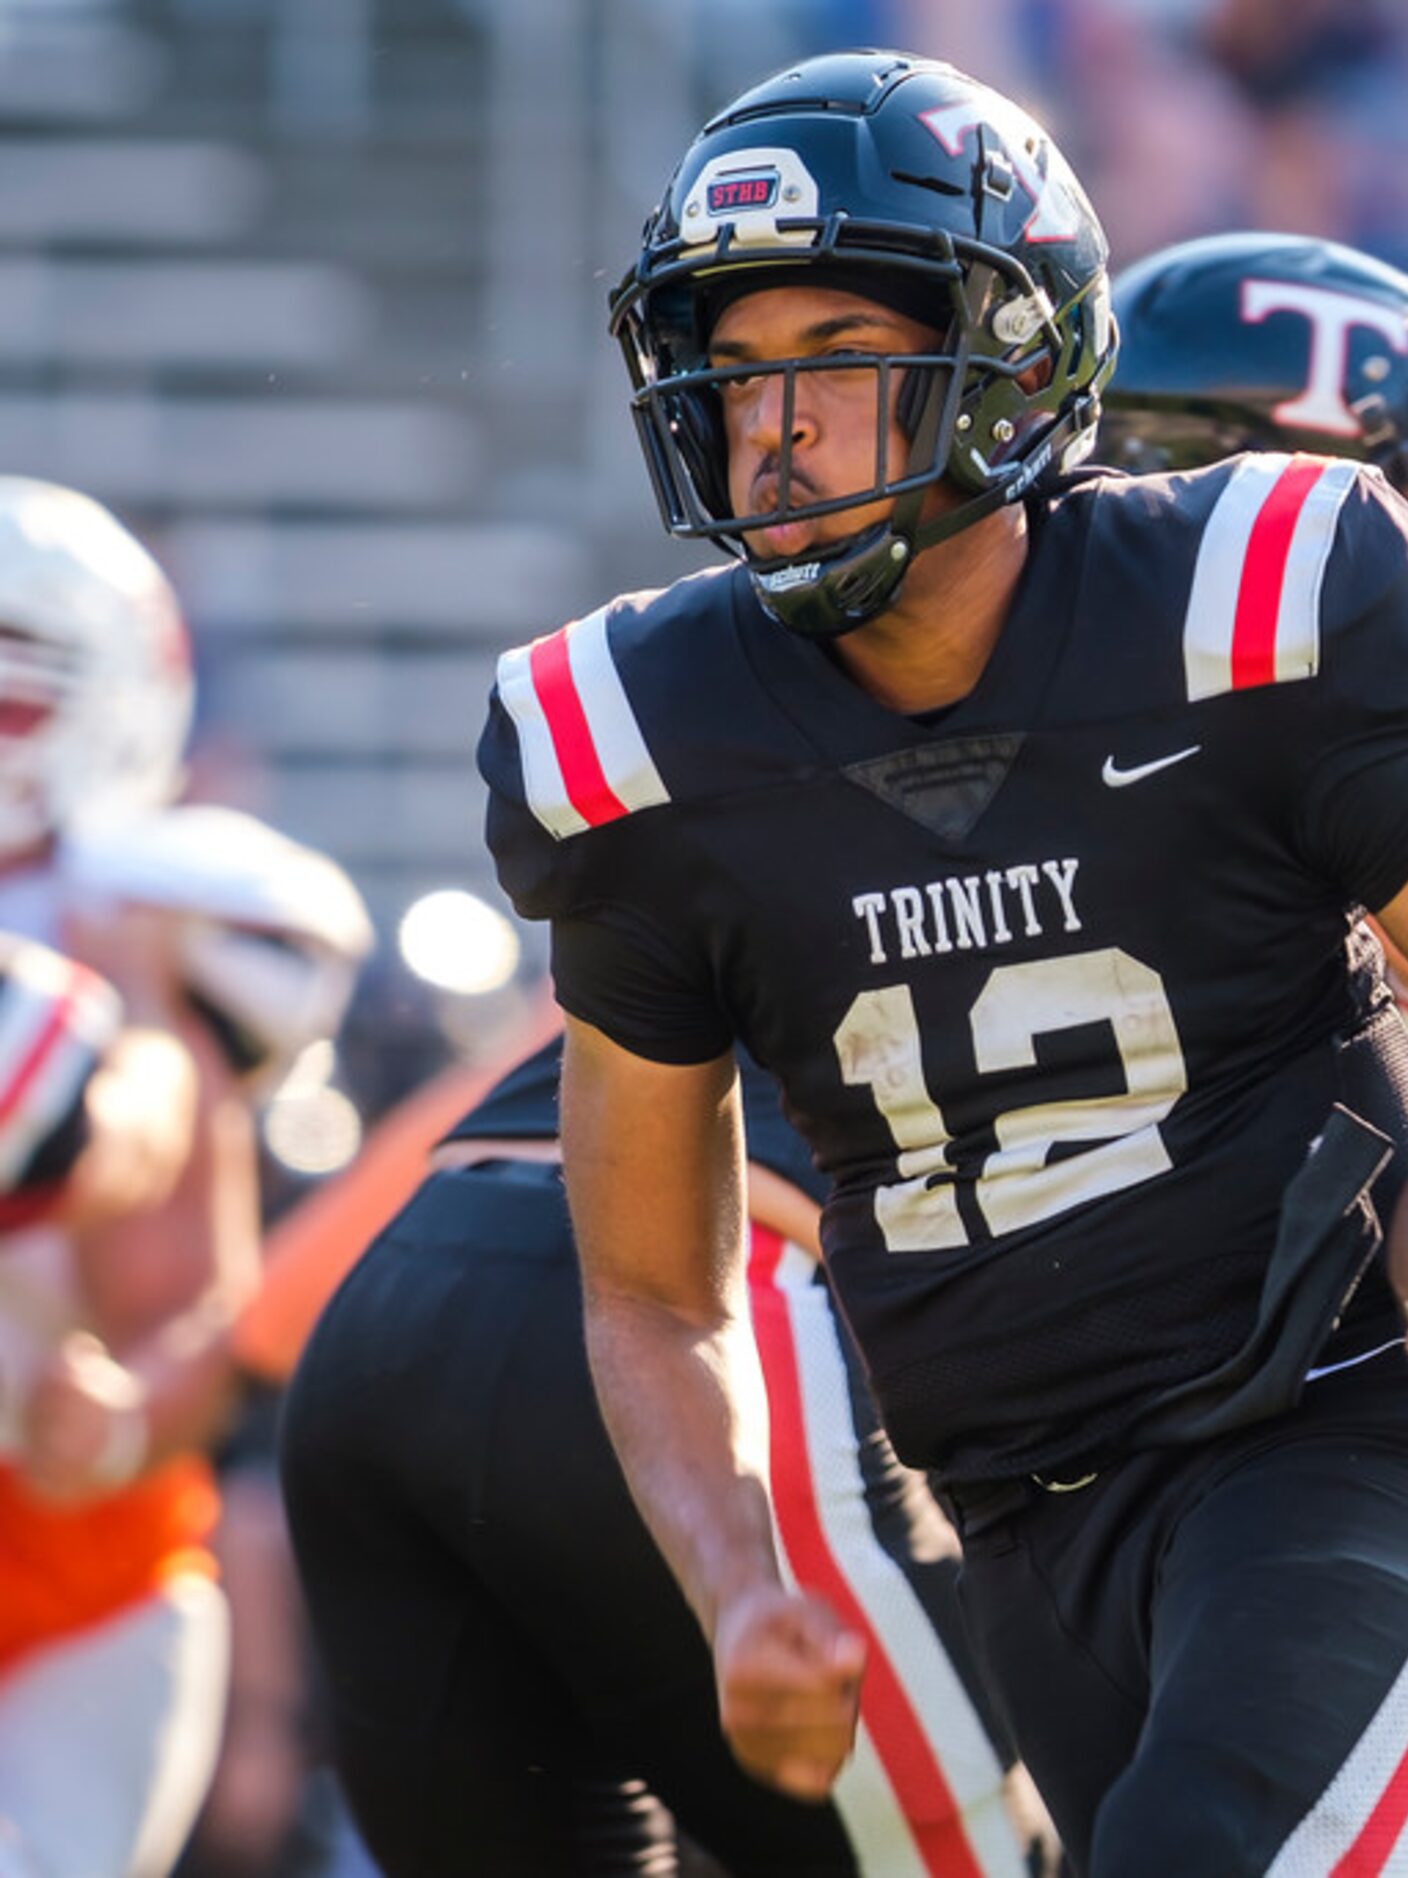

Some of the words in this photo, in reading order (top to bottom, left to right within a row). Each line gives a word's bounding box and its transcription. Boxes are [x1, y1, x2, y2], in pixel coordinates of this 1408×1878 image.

[712, 180, 768, 209] STHB
[852, 857, 1083, 965] TRINITY
[833, 947, 1187, 1253] 12
